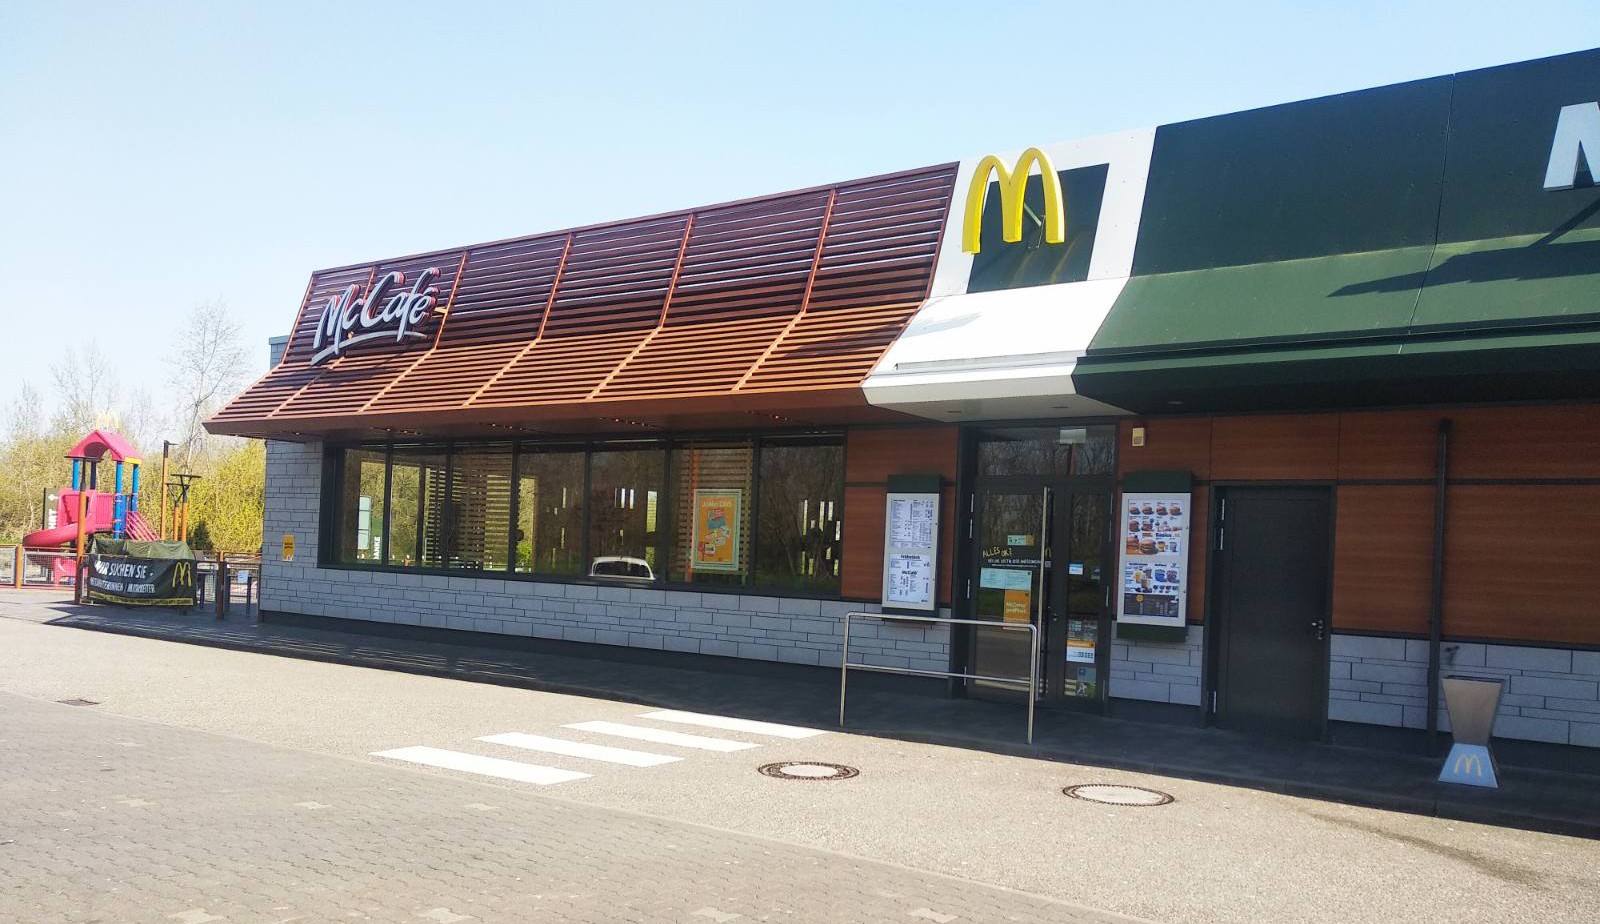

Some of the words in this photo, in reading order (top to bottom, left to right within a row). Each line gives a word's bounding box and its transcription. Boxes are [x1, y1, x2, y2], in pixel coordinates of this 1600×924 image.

[313, 267, 440, 355] McCafé
[982, 546, 1000, 558] ALLES
[94, 560, 108, 576] WIR
[109, 562, 136, 578] SUCHEN
[136, 565, 148, 579] SIE
